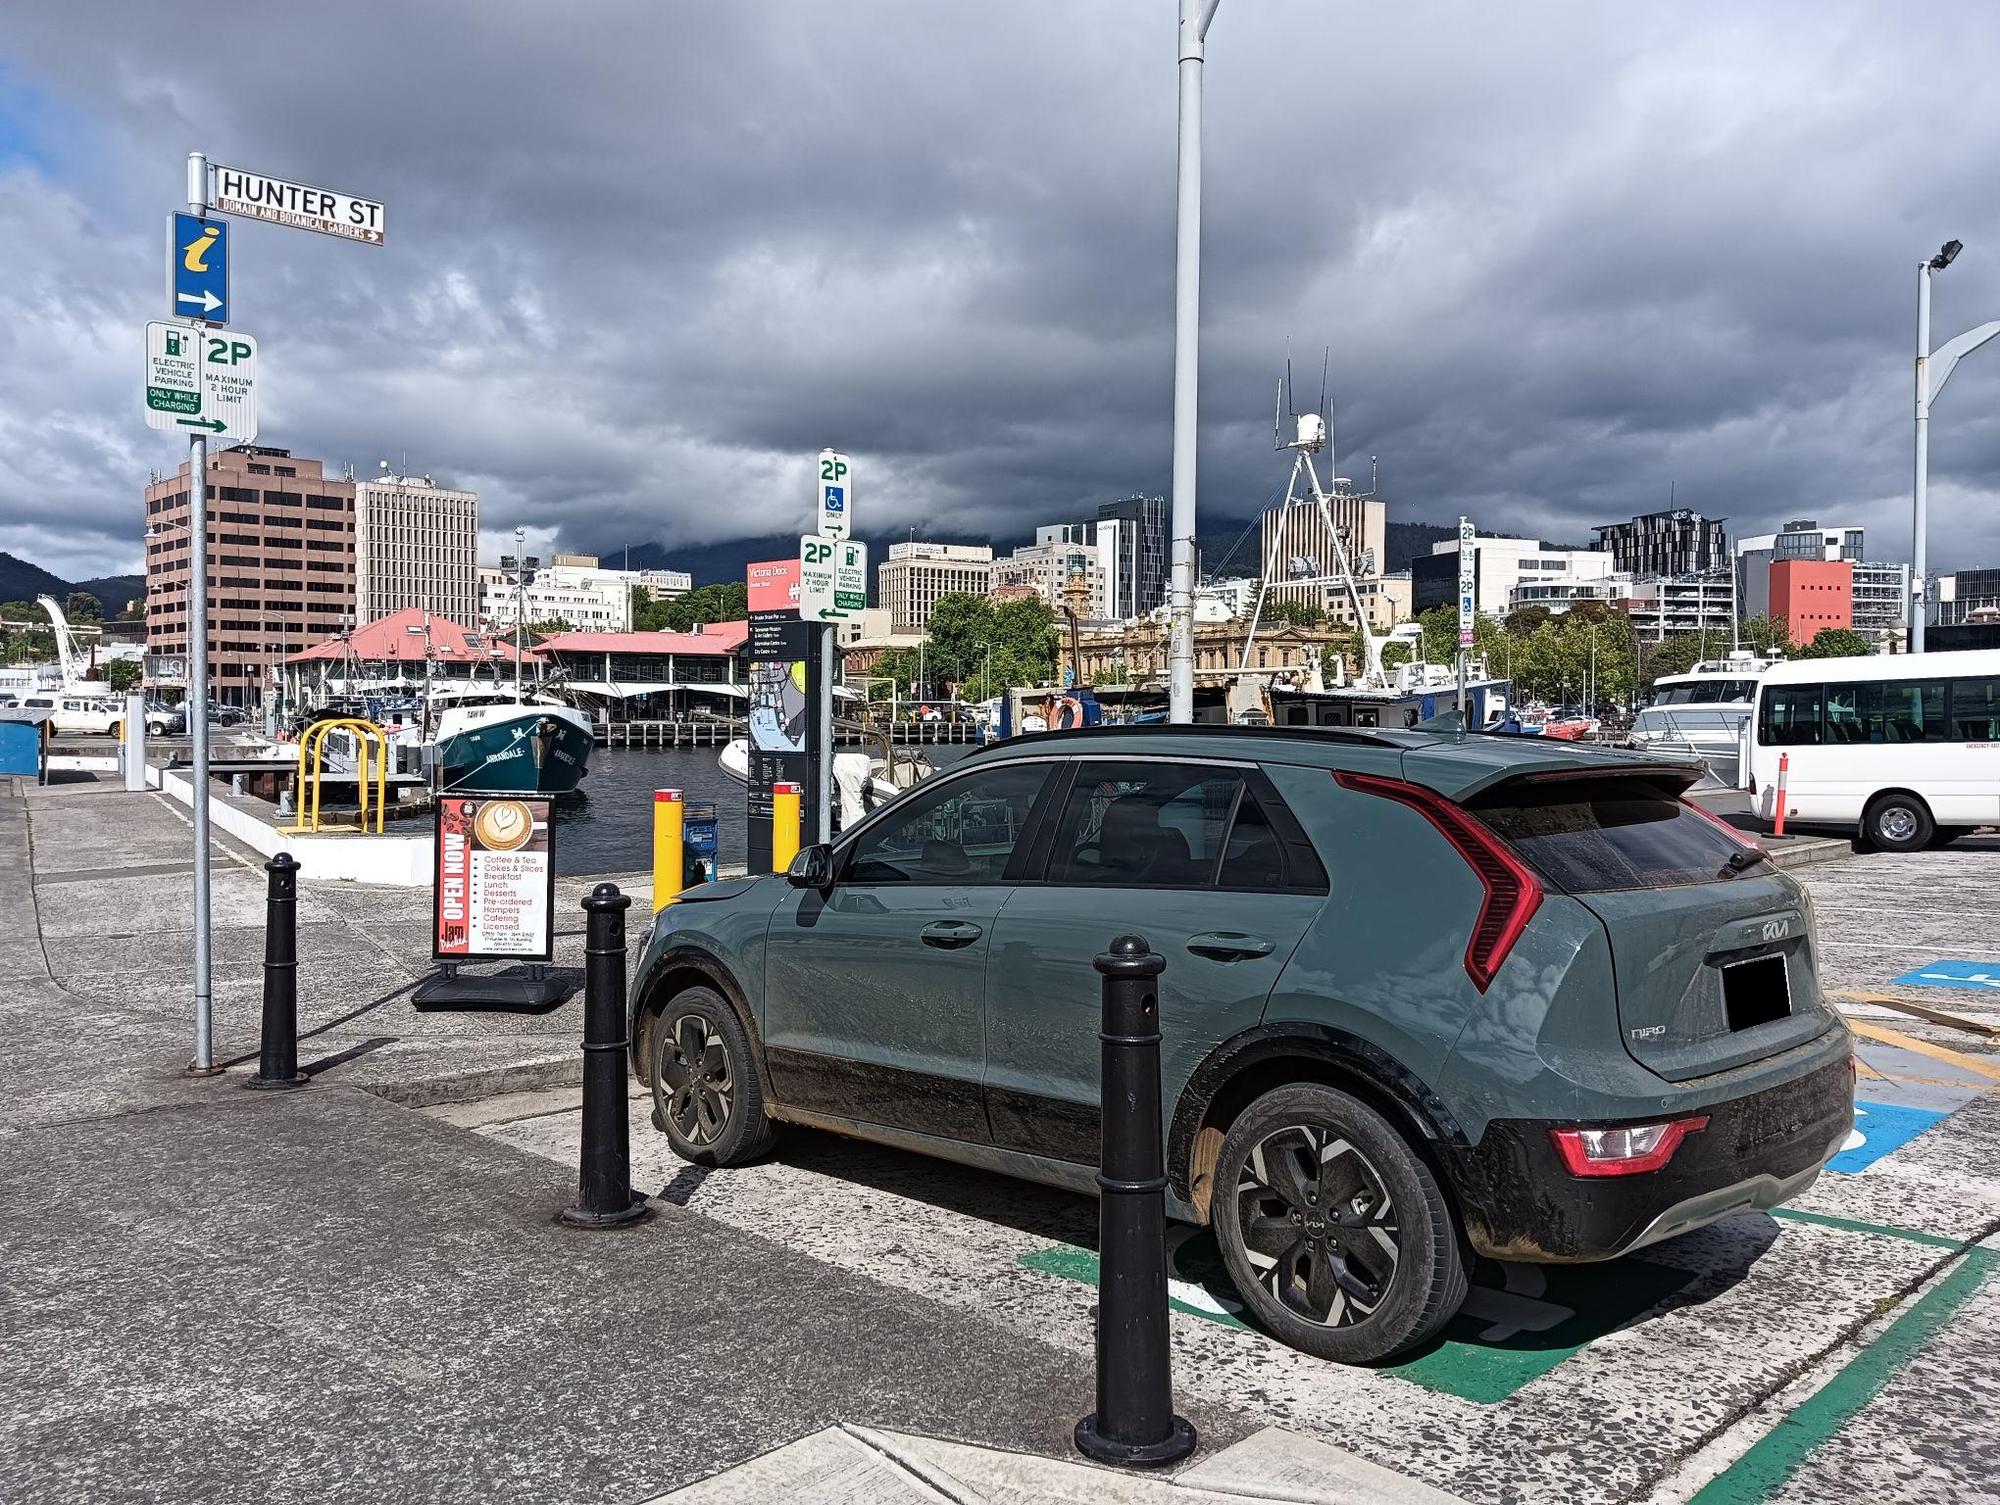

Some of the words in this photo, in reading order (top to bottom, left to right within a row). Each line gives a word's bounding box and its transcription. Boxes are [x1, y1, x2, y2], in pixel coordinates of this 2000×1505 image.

[224, 172, 336, 219] HUNTER
[349, 201, 380, 228] ST
[224, 199, 257, 216] DOMAIN
[260, 206, 277, 220] AND
[280, 211, 326, 230] BOTANICAL
[328, 221, 364, 239] GARDENS
[208, 338, 252, 366] 2P
[153, 357, 195, 370] ELECTRIC
[155, 366, 192, 379] VEHICLE
[154, 376, 194, 388] PARKING
[206, 373, 253, 387] MAXIMUM
[150, 388, 172, 400] ONLY
[173, 391, 198, 403] WHILE
[211, 383, 218, 392] 2
[220, 384, 248, 396] HOUR
[216, 392, 242, 404] LIMIT
[153, 399, 195, 412] CHARGING
[821, 460, 847, 481] 2P
[1462, 527, 1474, 540] 2P
[804, 542, 832, 564] 2P
[803, 570, 832, 579] MAXIMUM
[838, 568, 862, 576] ELECTRIC
[839, 575, 861, 583] VEHICLE
[839, 582, 861, 590] PARKING
[1461, 581, 1473, 594] 2P
[444, 833, 465, 874] NOW
[484, 856, 512, 864] Coffee
[443, 878, 464, 920] OPEN
[483, 914, 519, 923] Catering
[441, 922, 464, 941] Jam
